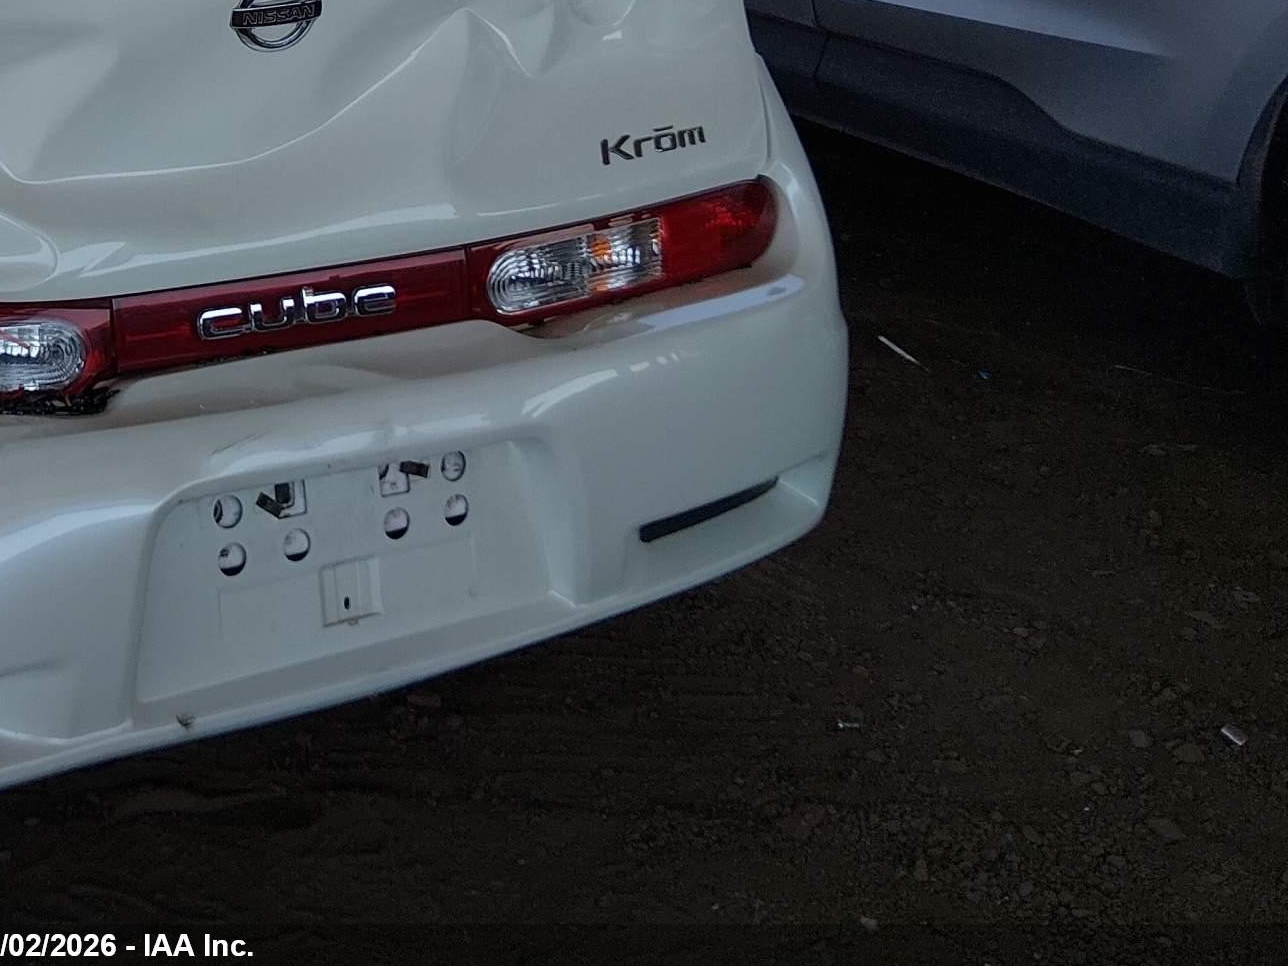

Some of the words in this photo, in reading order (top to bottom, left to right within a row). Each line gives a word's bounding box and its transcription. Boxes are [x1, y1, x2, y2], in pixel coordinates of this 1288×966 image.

[242, 4, 315, 26] NISSAN
[600, 125, 706, 165] Krōm
[198, 286, 397, 340] cube
